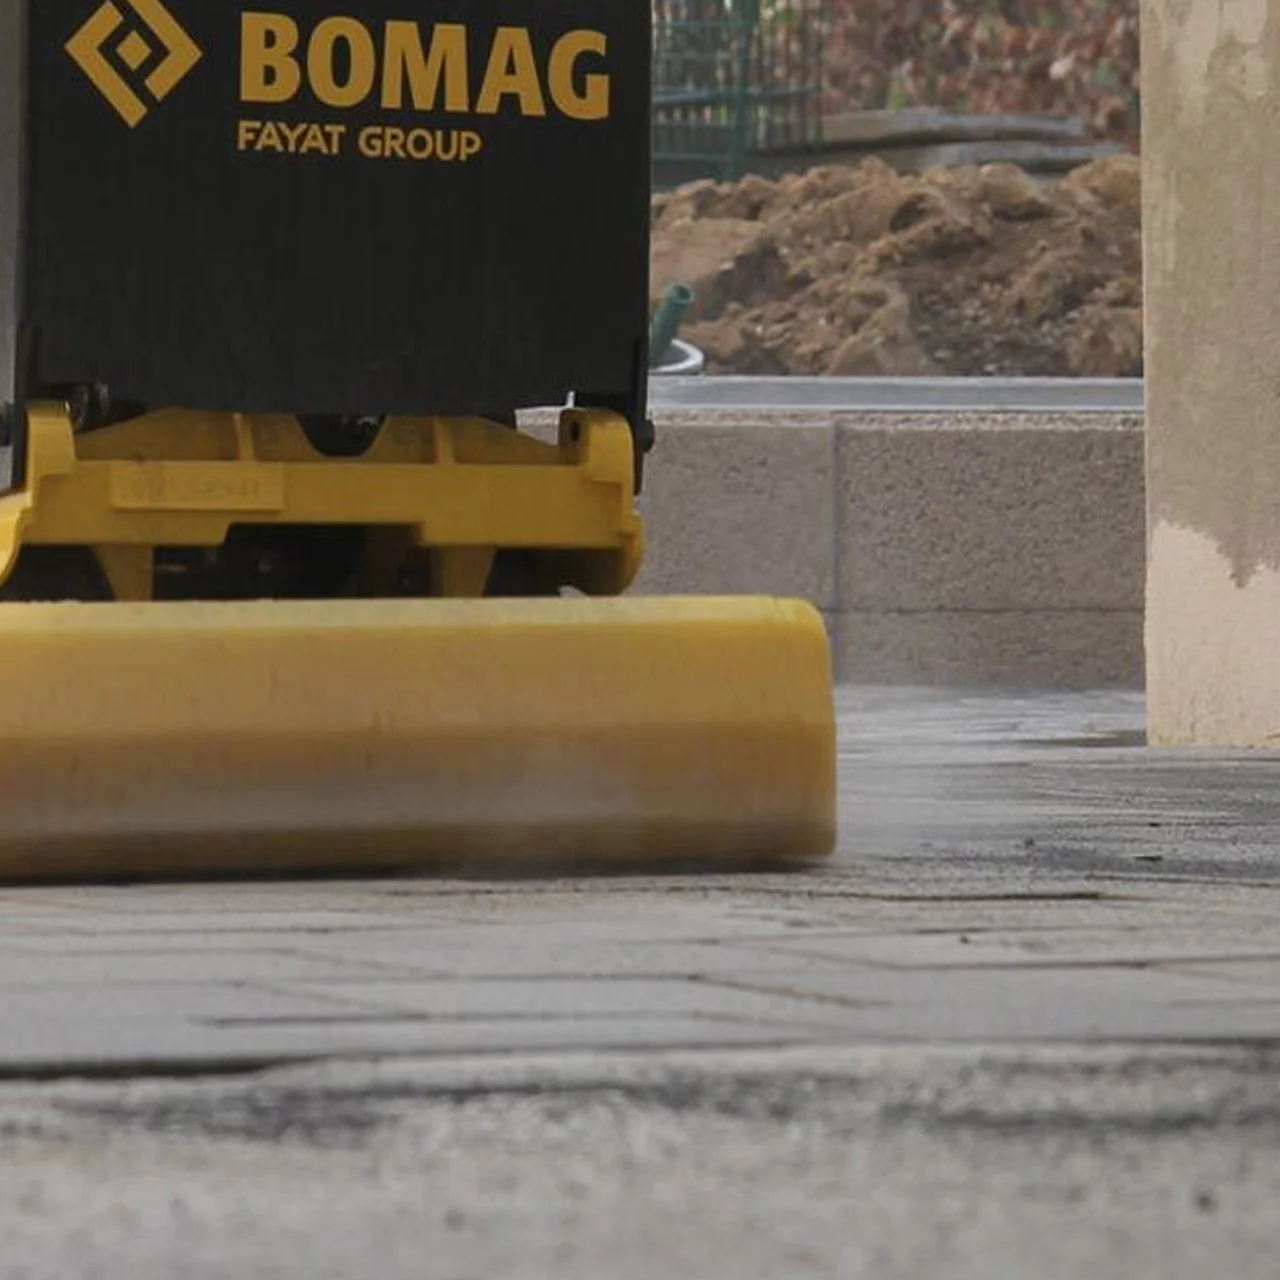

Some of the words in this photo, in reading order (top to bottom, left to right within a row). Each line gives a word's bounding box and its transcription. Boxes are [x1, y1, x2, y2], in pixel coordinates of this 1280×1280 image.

[240, 11, 610, 121] BOMAG
[237, 120, 348, 157] FAYAT
[358, 128, 482, 162] GROUP
